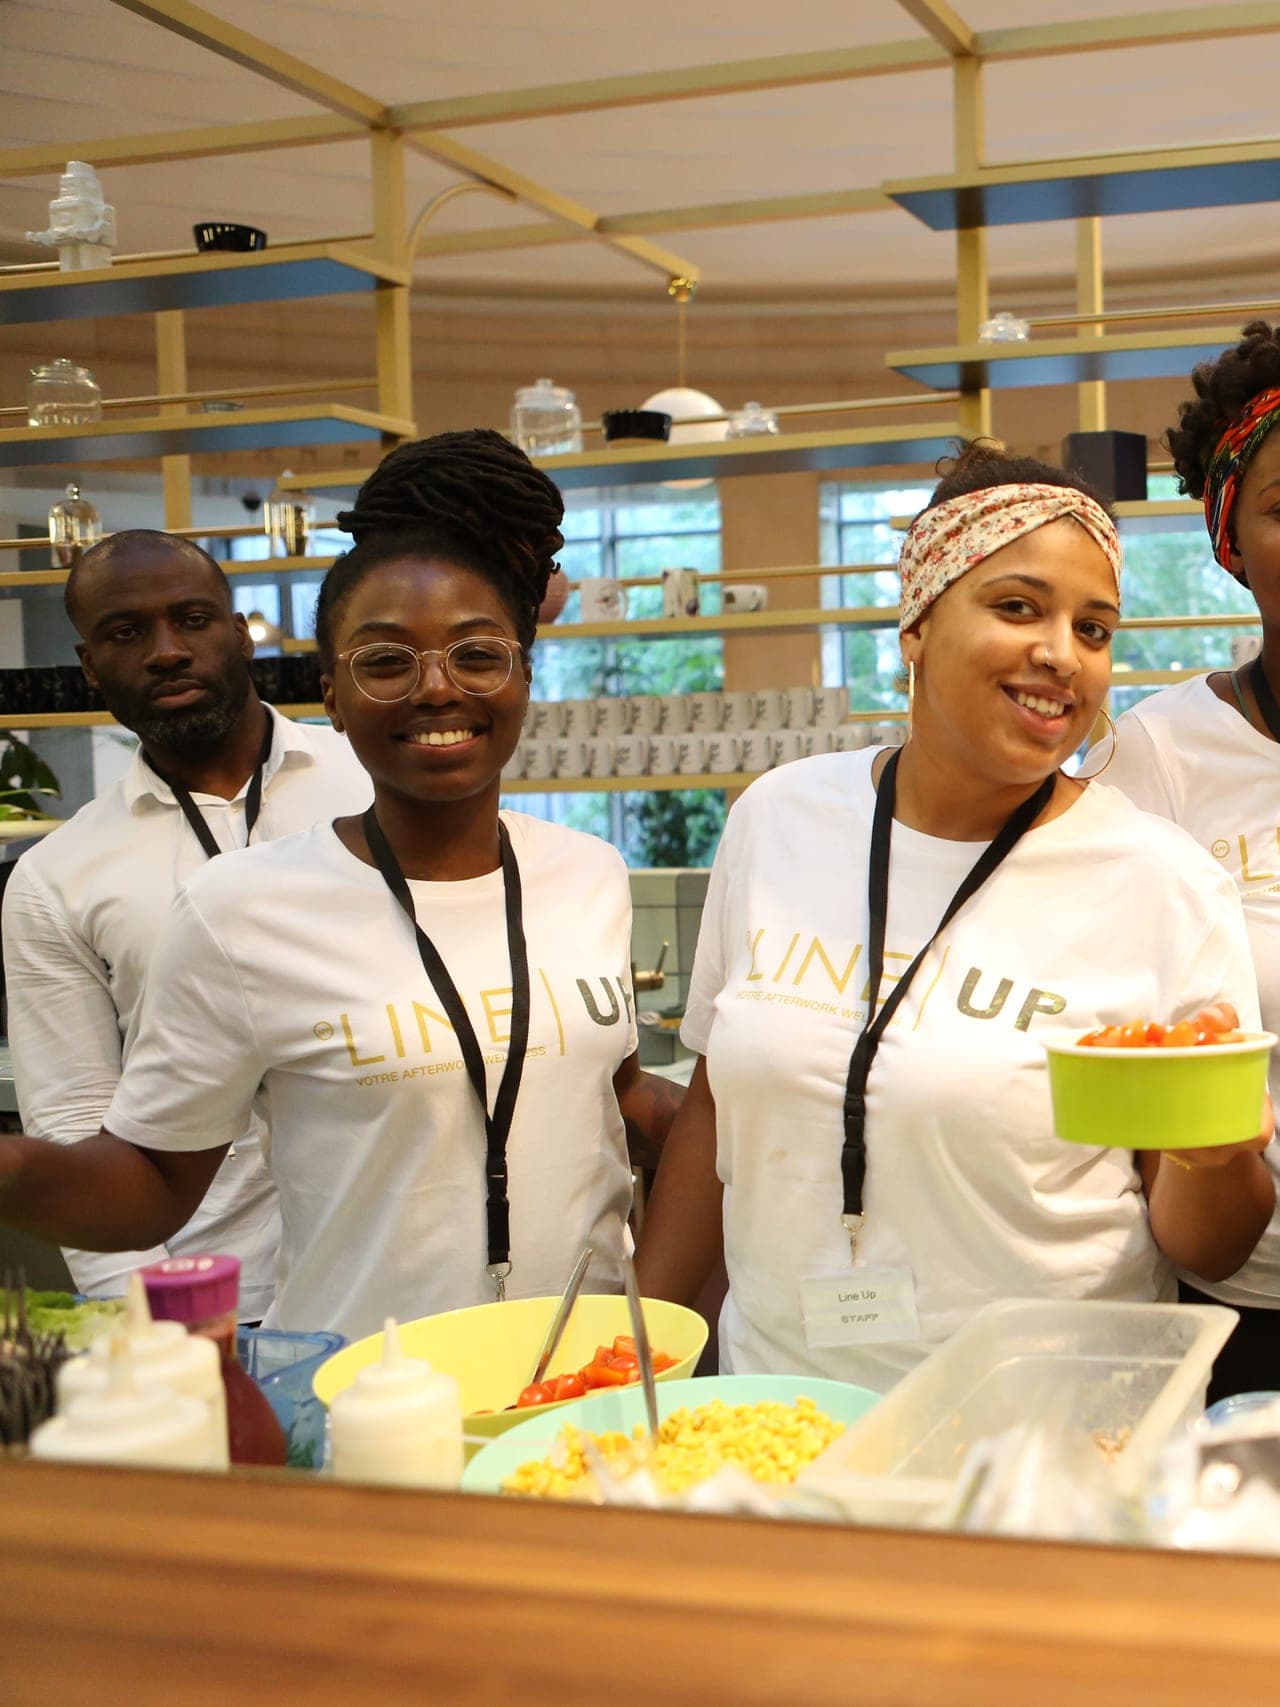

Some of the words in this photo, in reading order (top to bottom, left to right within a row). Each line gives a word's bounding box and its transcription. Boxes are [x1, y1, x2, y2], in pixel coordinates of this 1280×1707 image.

[745, 928, 914, 1005] LINE
[957, 966, 1067, 1033] UP
[763, 991, 840, 1015] AFTERWORK
[340, 986, 514, 1067] LINE
[355, 1071, 400, 1087] VOTRE
[402, 1059, 465, 1081] AFTERWO
[485, 1046, 547, 1066] WELESS
[838, 1293, 859, 1303] Line
[861, 1290, 876, 1300] Up
